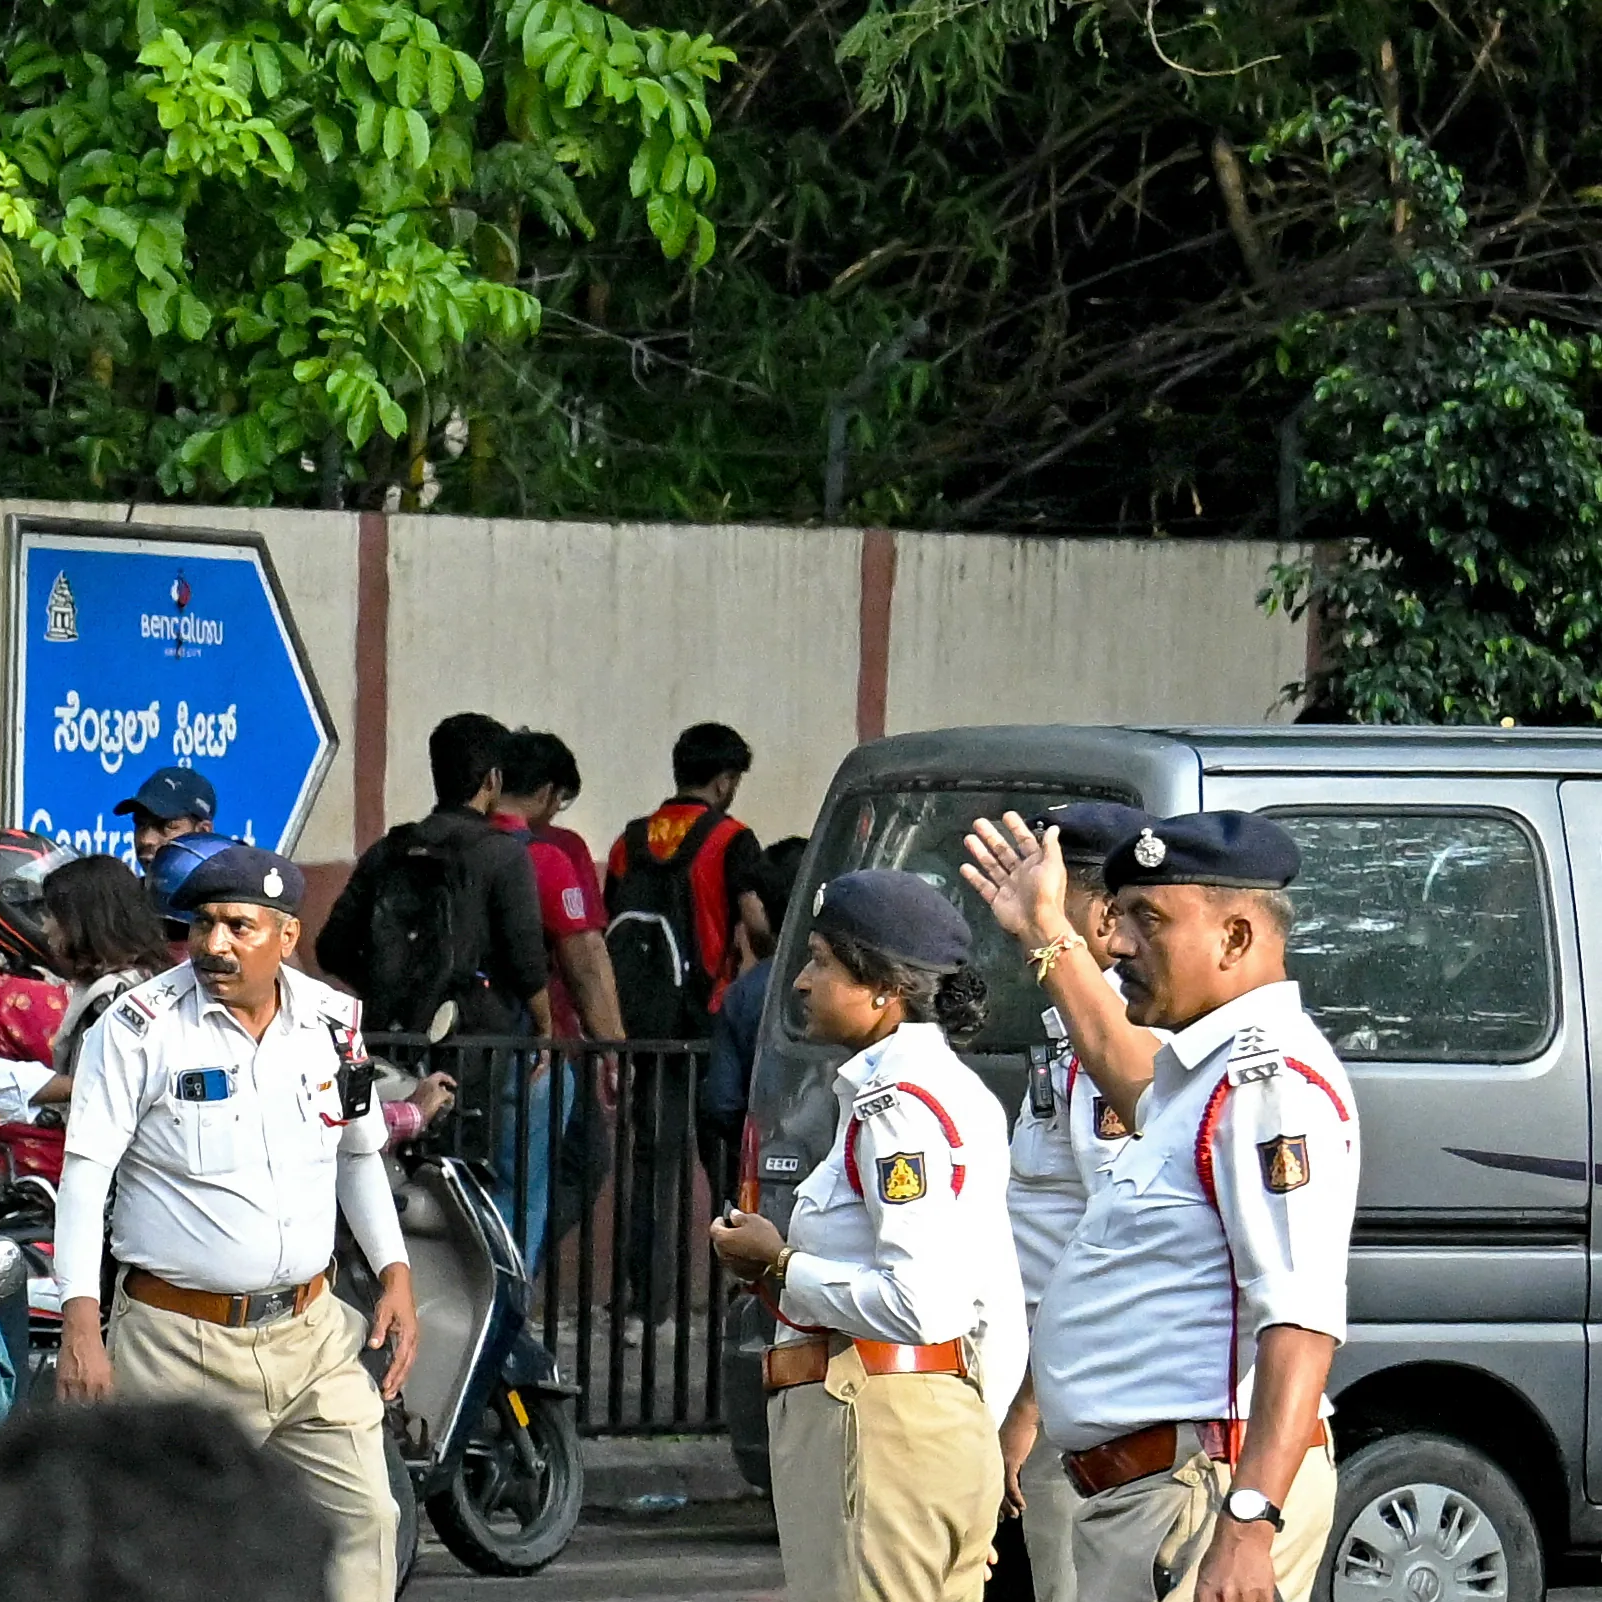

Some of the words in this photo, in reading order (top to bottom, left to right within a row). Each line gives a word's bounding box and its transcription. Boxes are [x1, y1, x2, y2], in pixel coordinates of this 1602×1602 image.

[54, 689, 160, 774] ಸೆಂಟ್ರಲ್
[29, 808, 138, 876] Cntra
[765, 1156, 799, 1173] EECO
